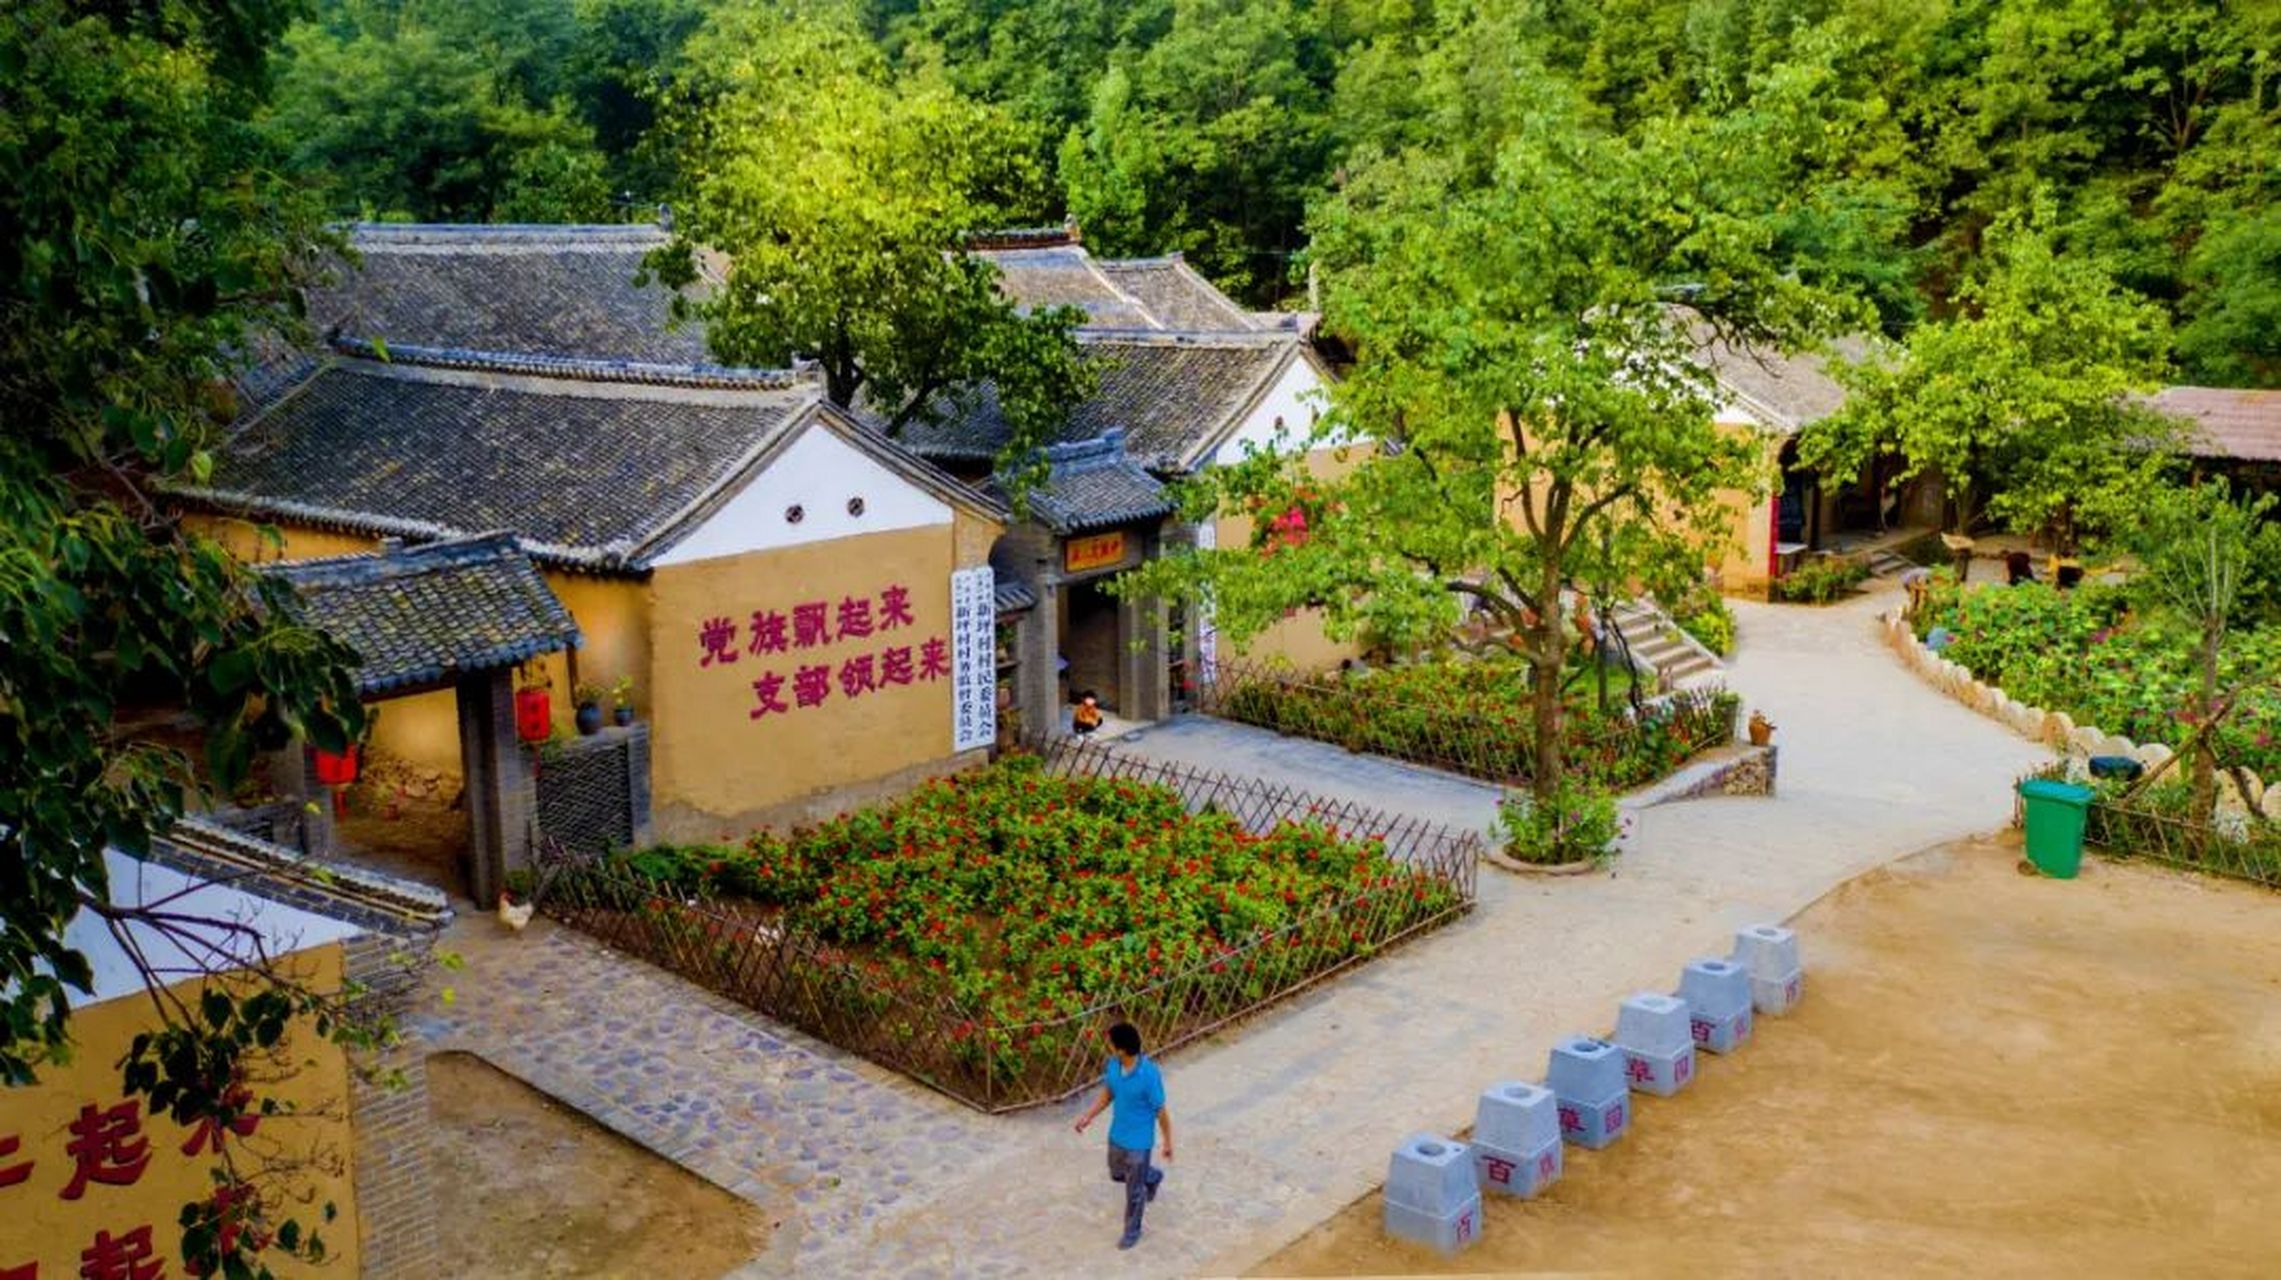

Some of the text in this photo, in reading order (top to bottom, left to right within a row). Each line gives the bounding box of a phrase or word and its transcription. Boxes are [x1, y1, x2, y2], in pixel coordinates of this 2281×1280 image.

[700, 584, 914, 668] 党旗飘起来
[750, 637, 950, 720] 支部领起来
[1481, 1154, 1517, 1185] 百
